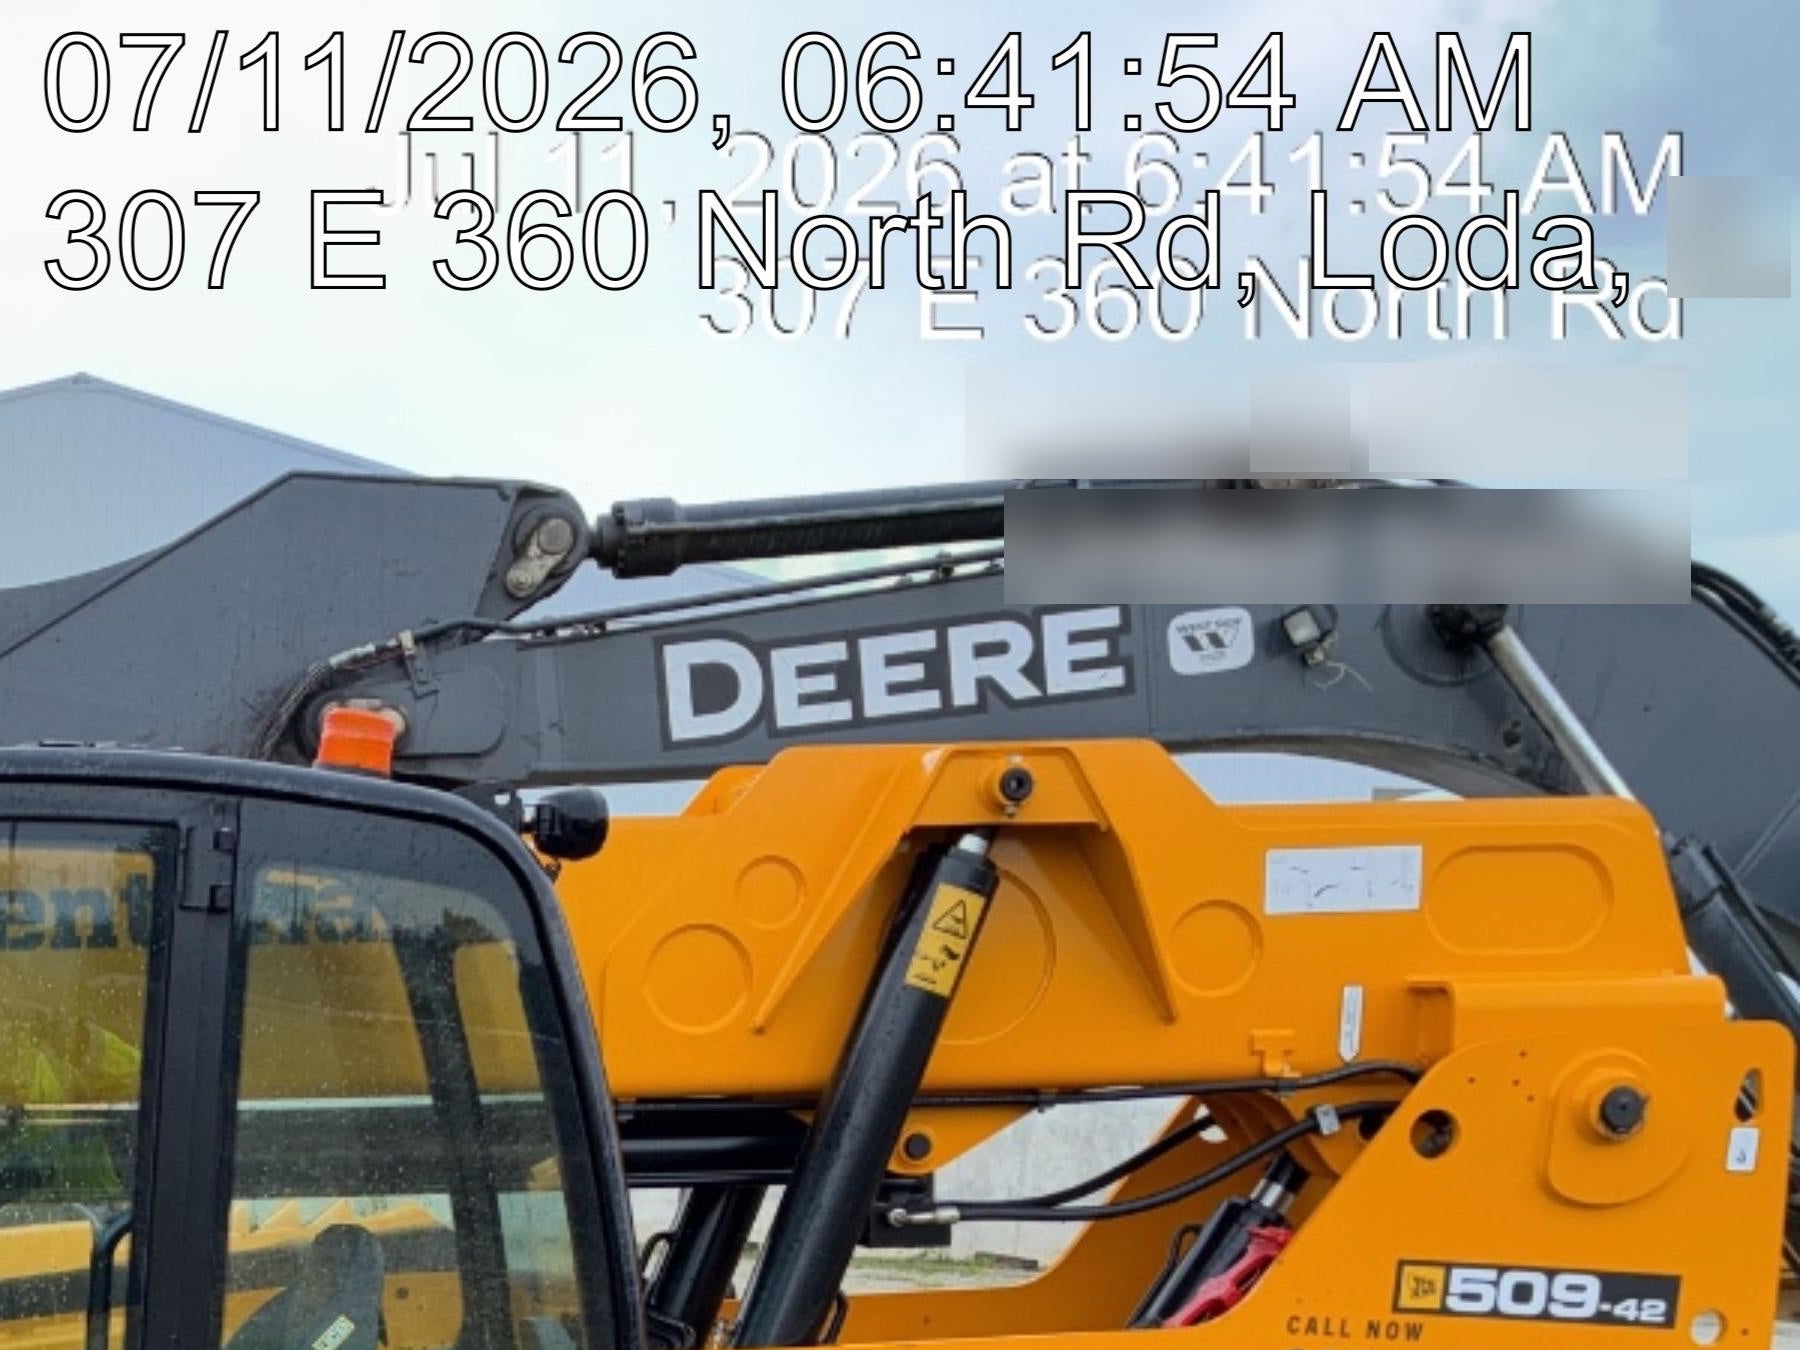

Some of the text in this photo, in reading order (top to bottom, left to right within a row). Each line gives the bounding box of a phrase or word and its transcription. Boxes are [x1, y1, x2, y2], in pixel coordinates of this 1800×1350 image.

[661, 605, 1126, 743] DEERE
[1445, 1266, 1667, 1324] 509-42
[1286, 1316, 1424, 1341] CALL NOW
